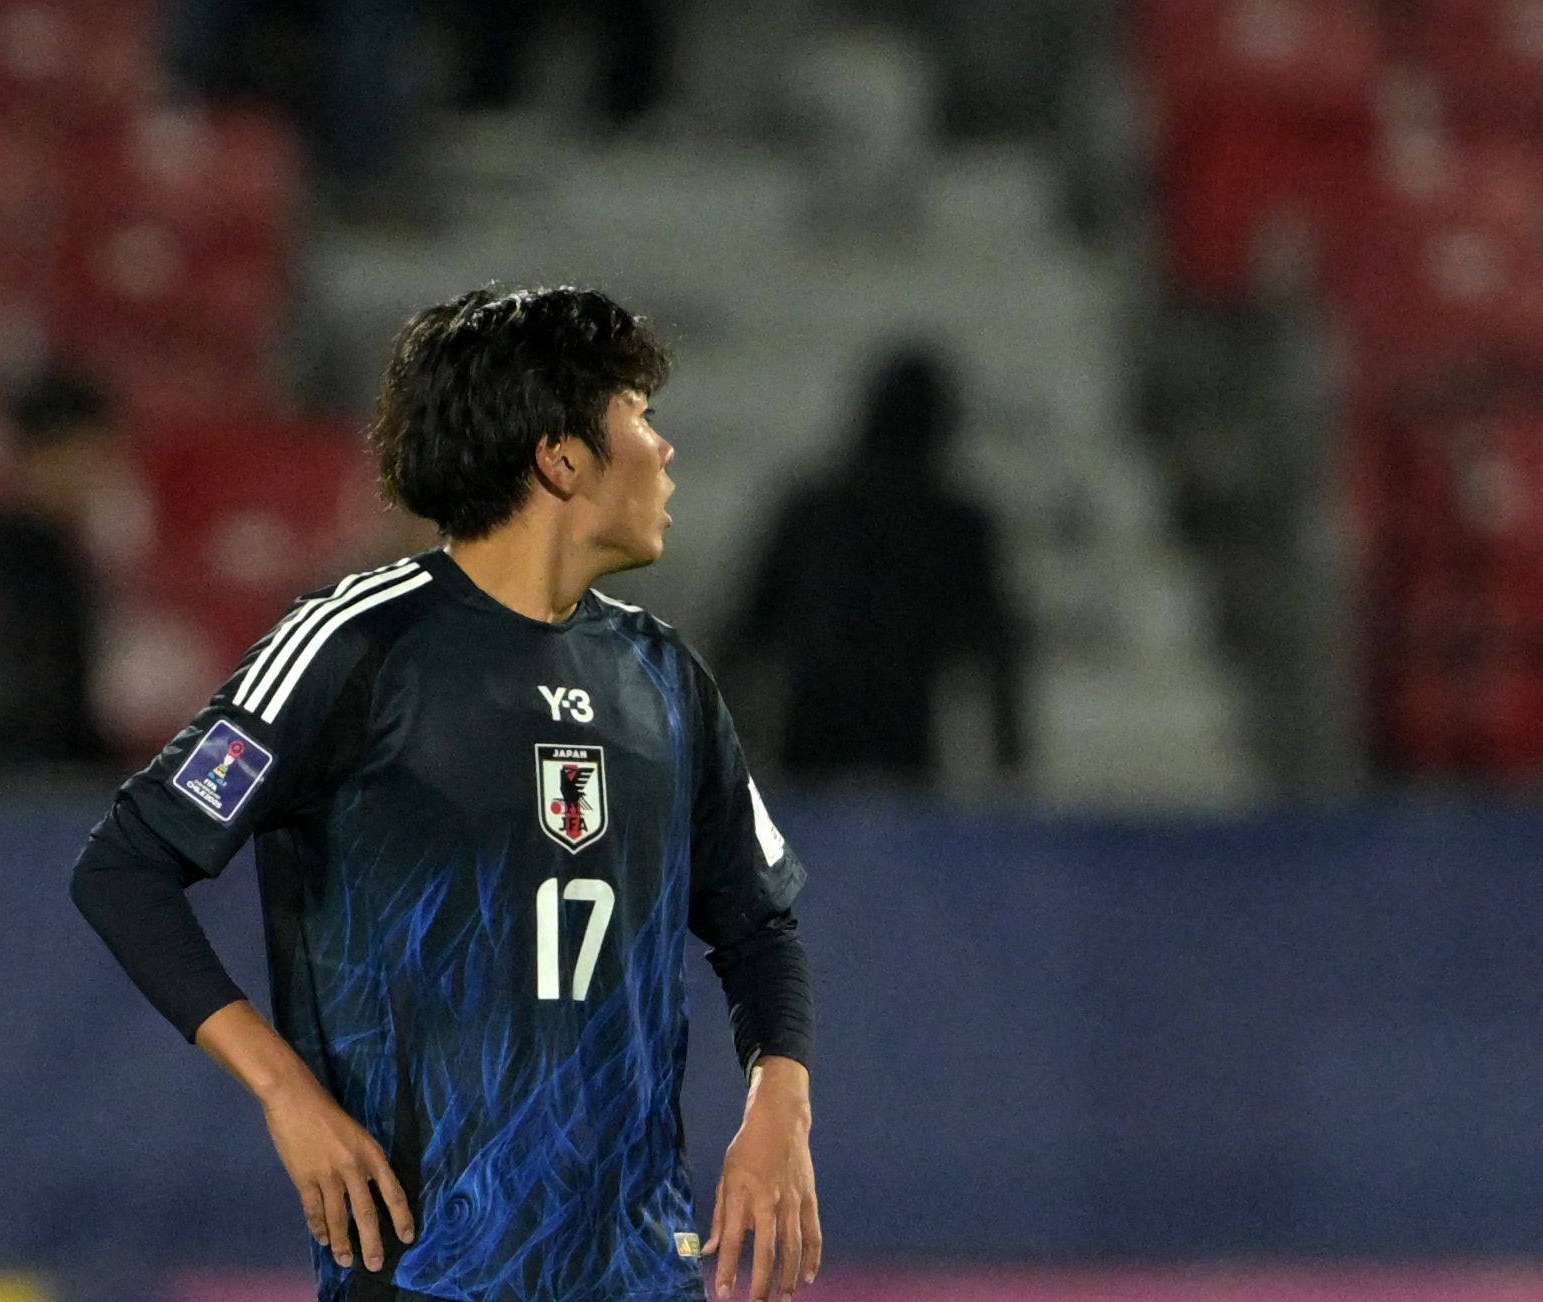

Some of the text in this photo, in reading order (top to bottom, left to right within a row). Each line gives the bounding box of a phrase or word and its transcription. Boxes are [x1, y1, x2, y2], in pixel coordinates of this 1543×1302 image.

[537, 685, 595, 723] Y-3
[552, 748, 588, 759] JAPAN
[559, 816, 589, 833] JFA
[536, 876, 615, 1001] 17
